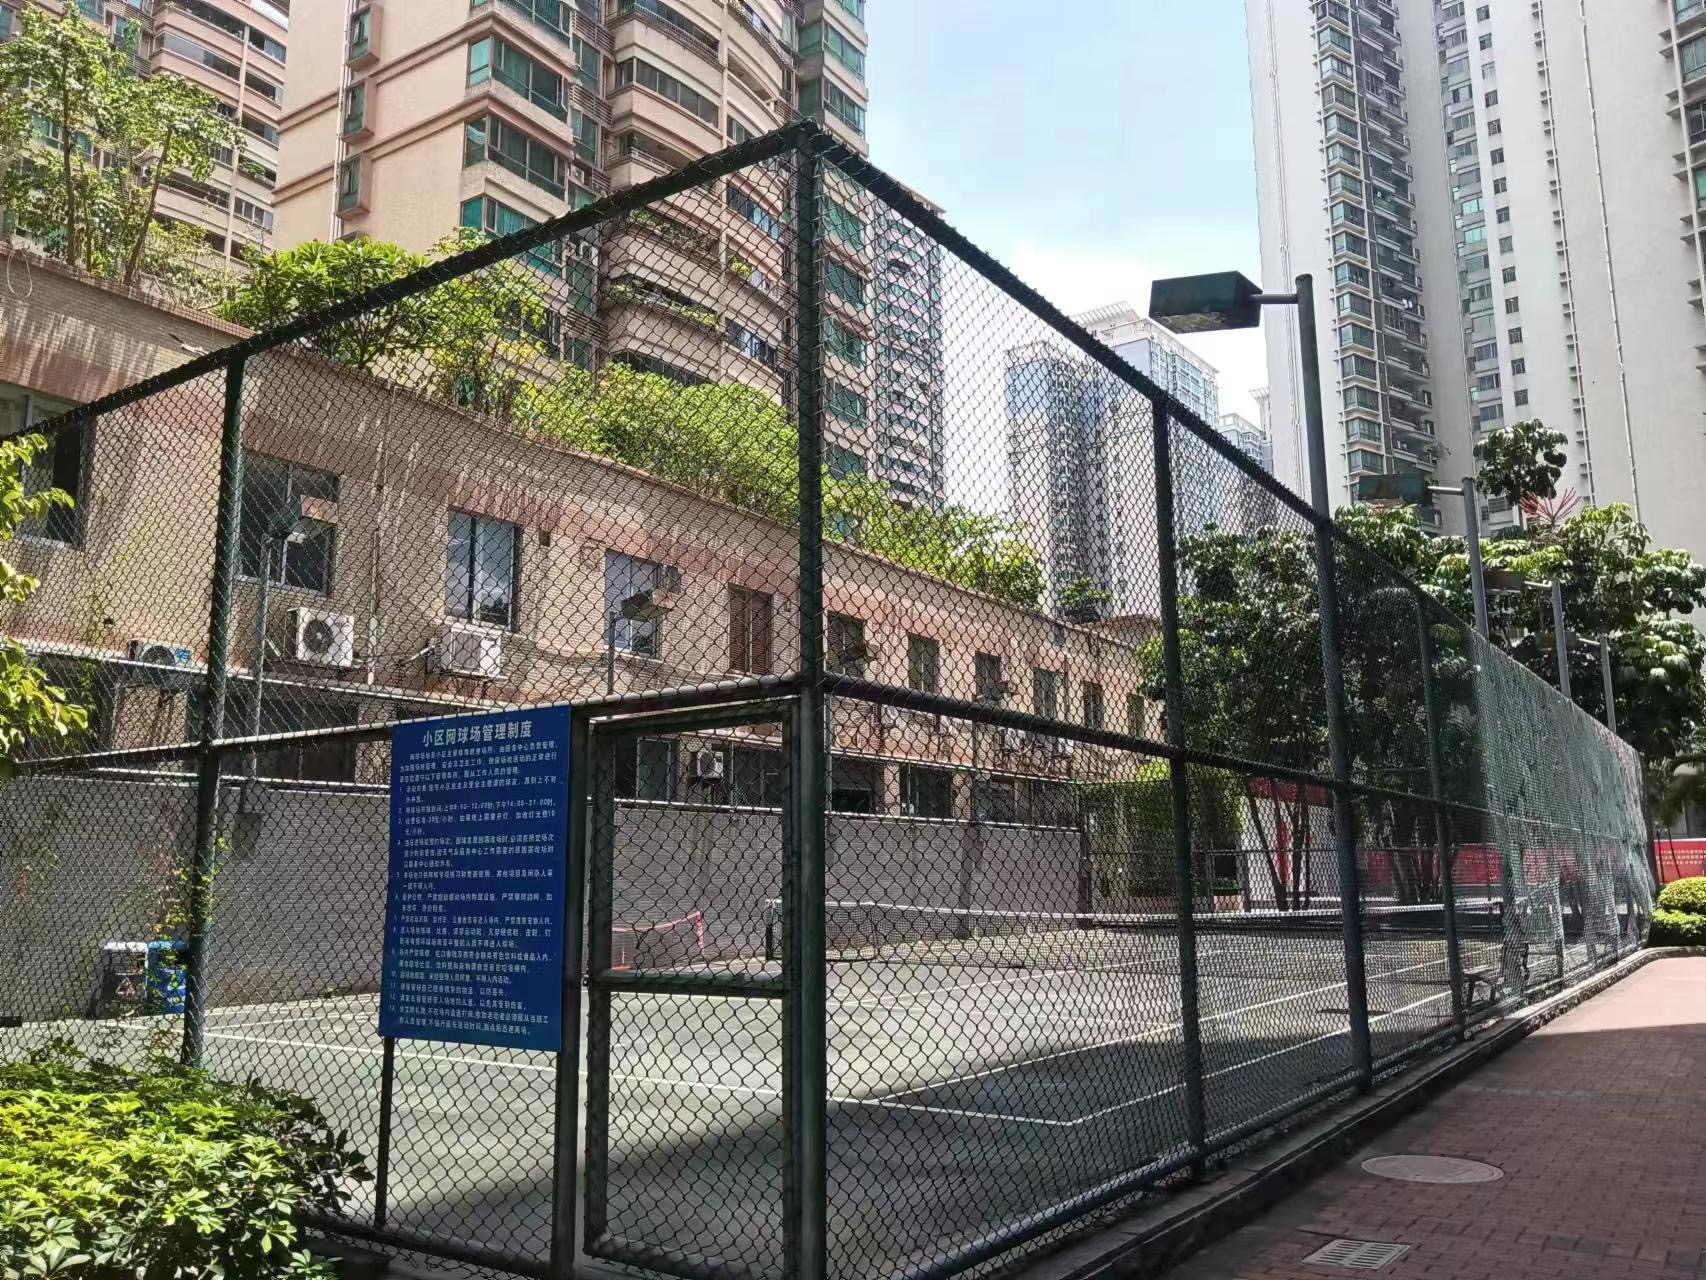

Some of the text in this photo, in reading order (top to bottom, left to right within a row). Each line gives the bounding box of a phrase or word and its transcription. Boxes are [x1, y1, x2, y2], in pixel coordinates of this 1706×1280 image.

[422, 720, 533, 748] 小区网球场管理制度
